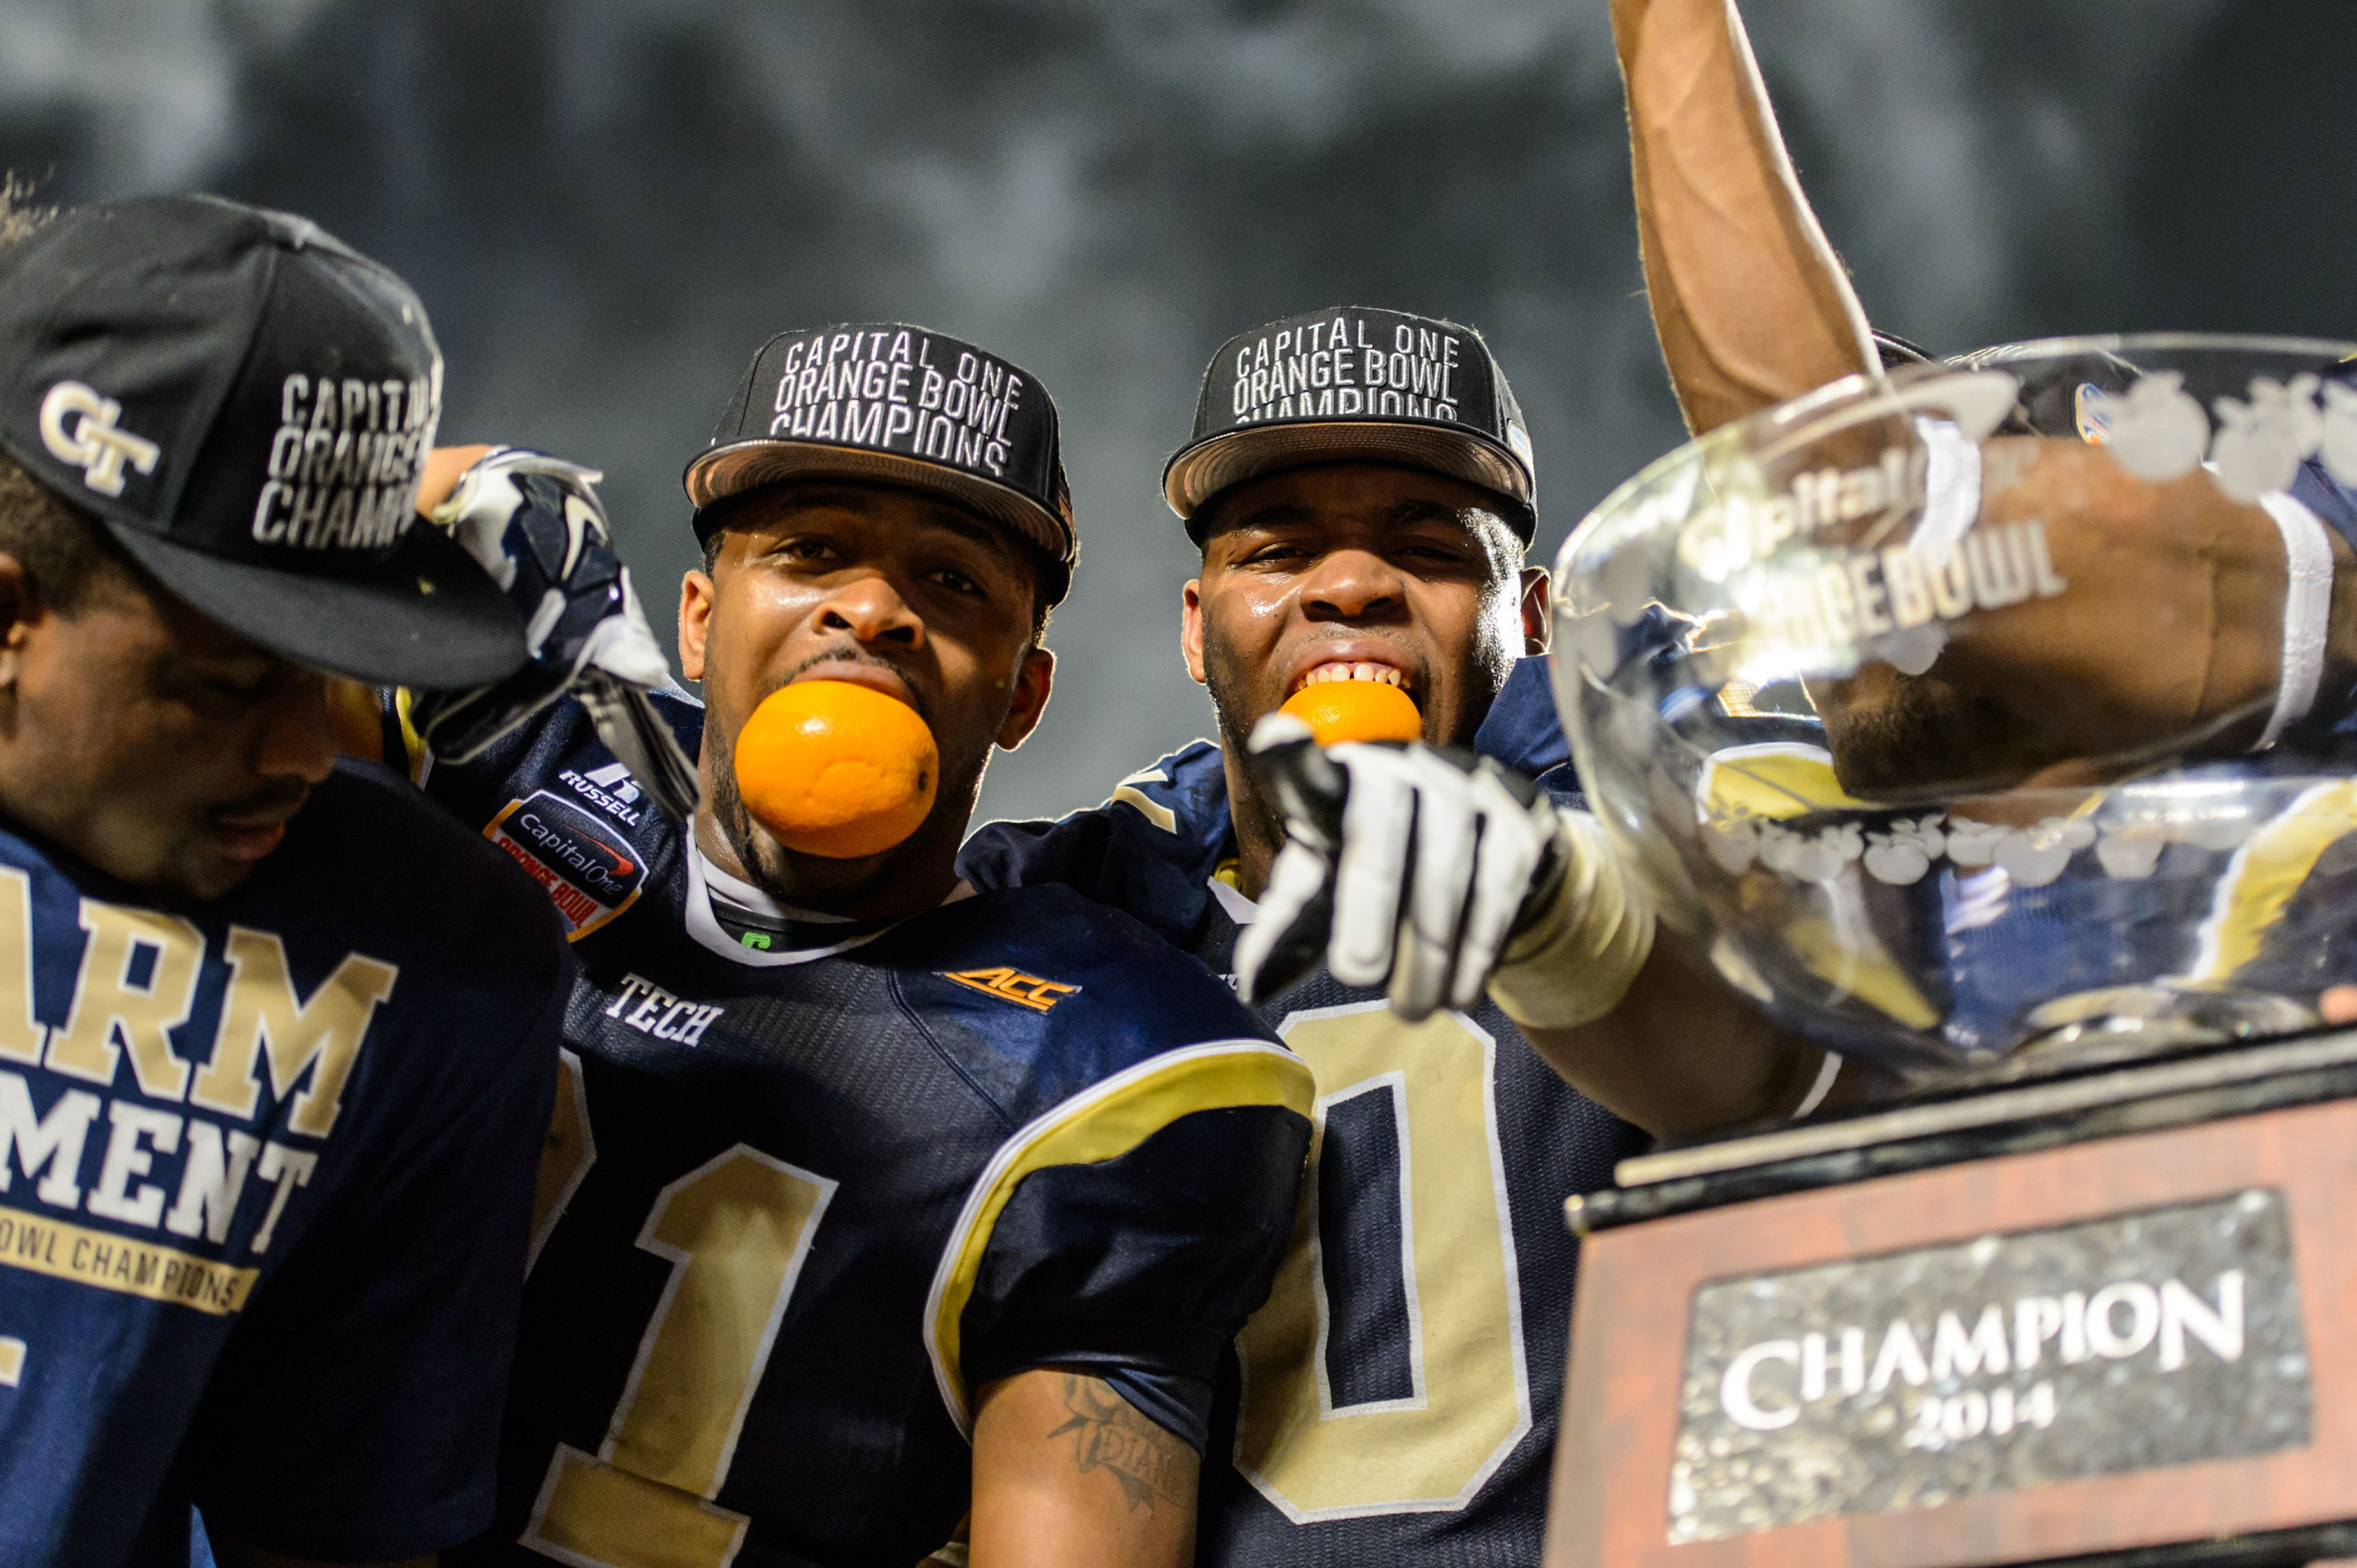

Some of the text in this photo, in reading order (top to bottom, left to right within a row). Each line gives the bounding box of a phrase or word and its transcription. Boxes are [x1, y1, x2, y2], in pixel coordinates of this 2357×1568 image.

[785, 330, 1023, 409] CAPITAL ONE
[1233, 348, 1459, 417] ORANGE BOWL
[1236, 317, 1459, 378] CAPITAL ONE
[770, 399, 1008, 477] CHAMPIONS
[773, 359, 1013, 447] ORANGE BOWL
[1235, 388, 1458, 424] MPIONS
[559, 769, 641, 826] RUSSELL
[552, 882, 600, 929] BOWL
[605, 972, 725, 1048] TECH
[944, 966, 1075, 1011] ACC
[71, 1237, 241, 1311] CHAMPIONS
[519, 1047, 841, 1568] 1
[1720, 1269, 2246, 1430] CHAMPION
[1904, 1380, 2055, 1451] 2014
